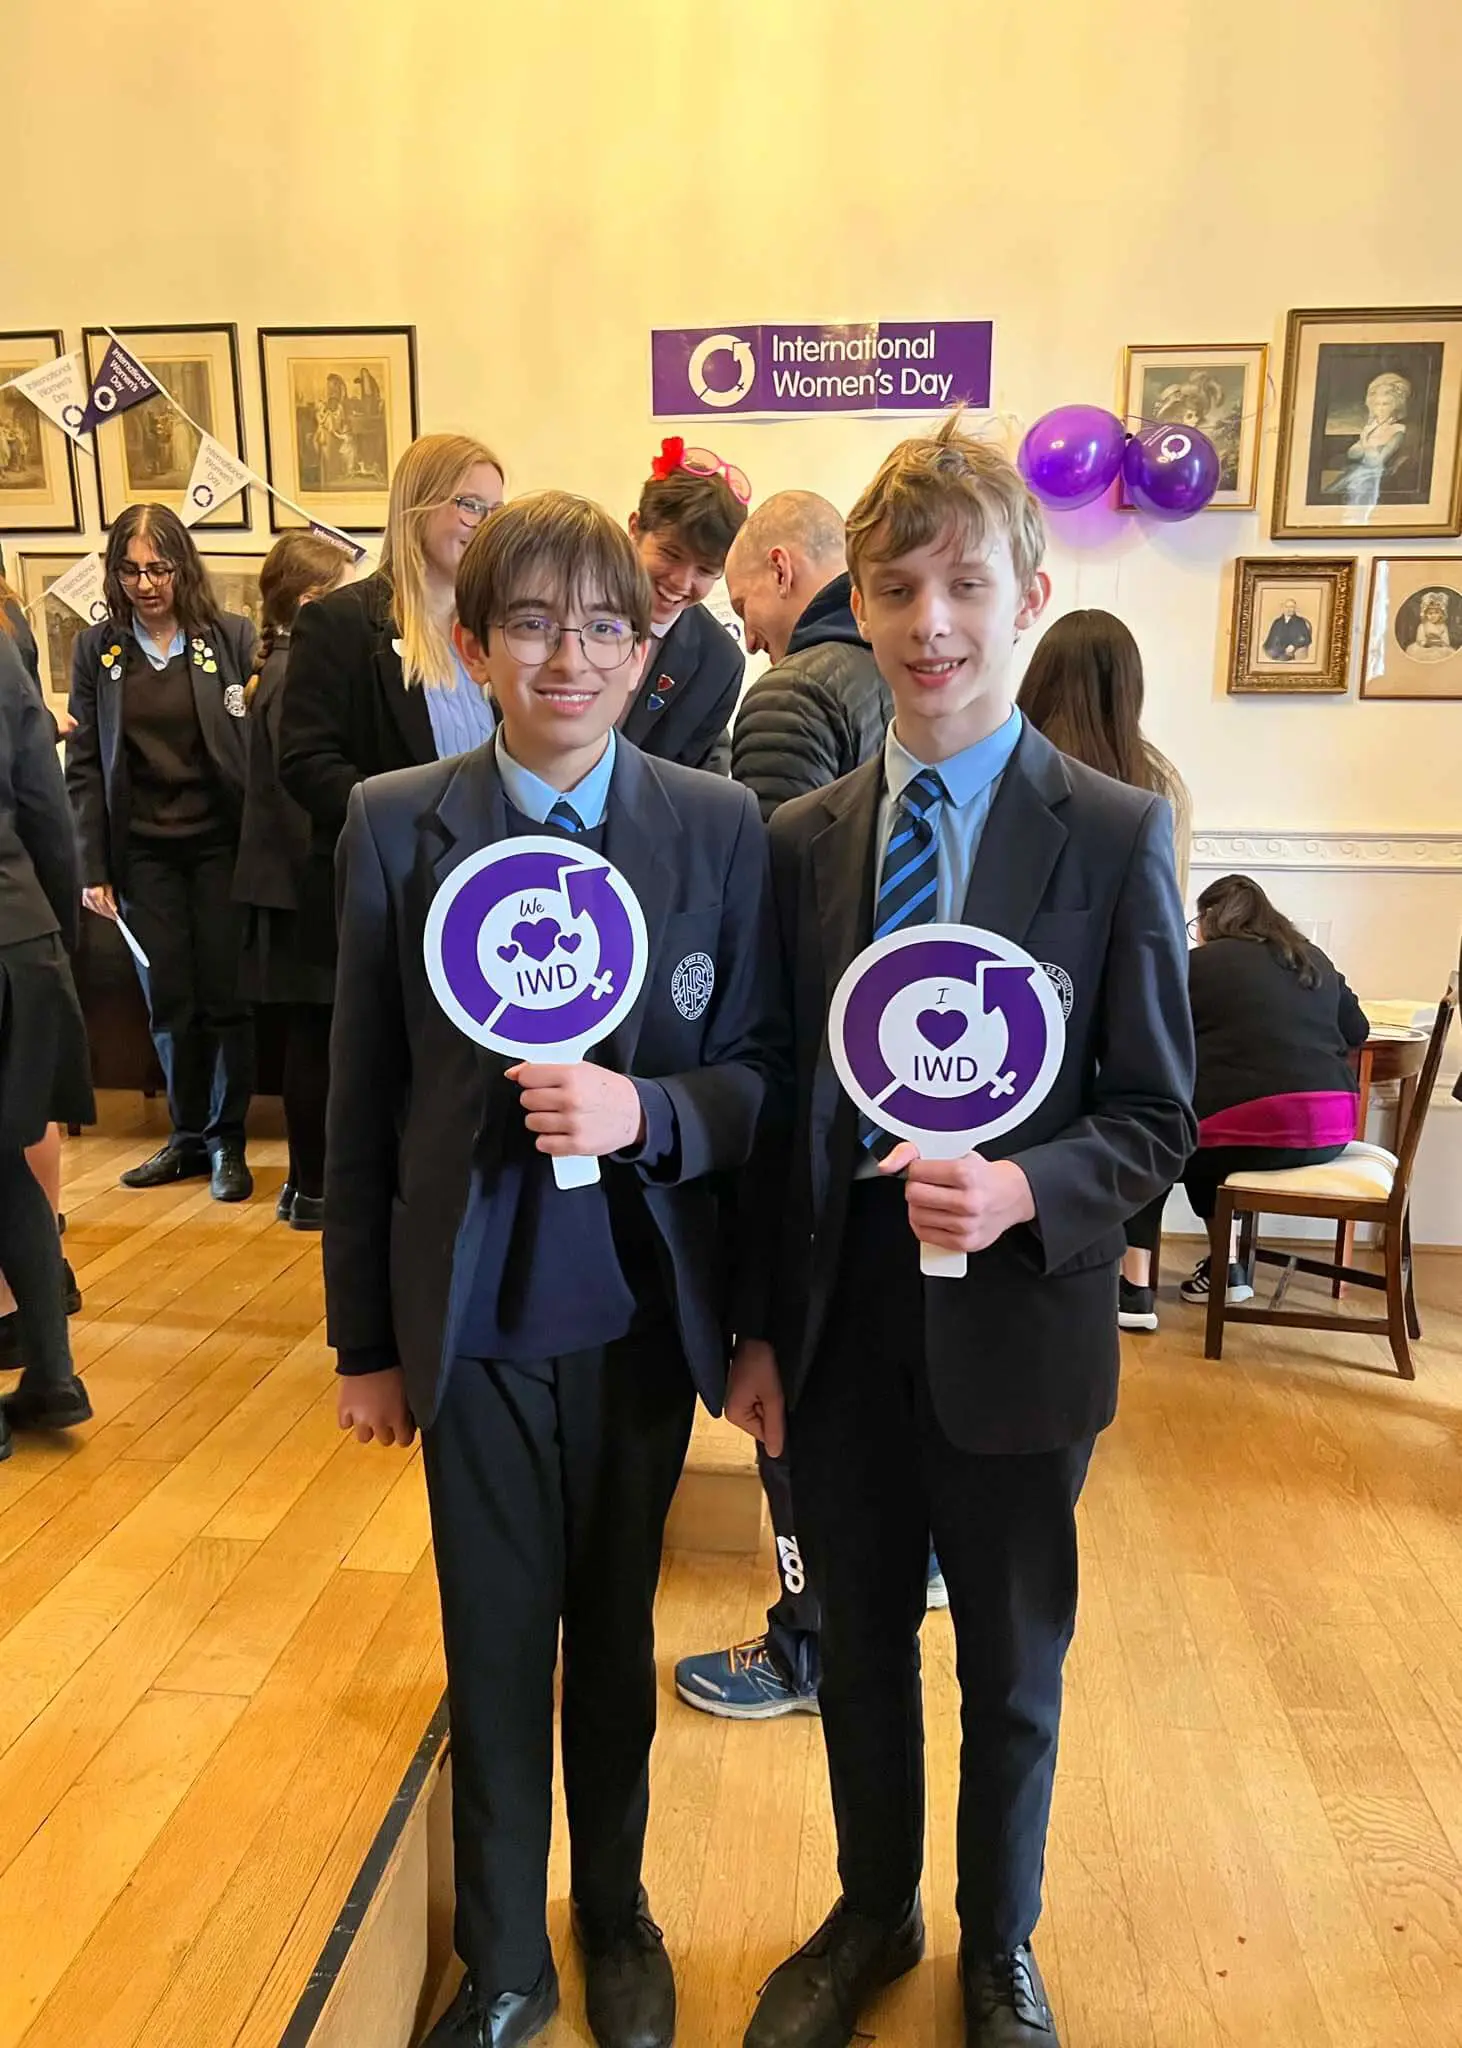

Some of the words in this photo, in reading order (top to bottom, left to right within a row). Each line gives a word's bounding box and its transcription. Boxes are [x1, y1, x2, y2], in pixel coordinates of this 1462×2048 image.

[772, 329, 936, 363] International
[109, 359, 139, 393] Women's
[110, 374, 125, 393] Day
[111, 347, 153, 390] International
[772, 367, 894, 398] Women's
[900, 367, 954, 402] Day
[519, 897, 546, 918] We
[516, 963, 579, 997] IWD
[935, 987, 950, 1005] I
[913, 1055, 978, 1082] IWD
